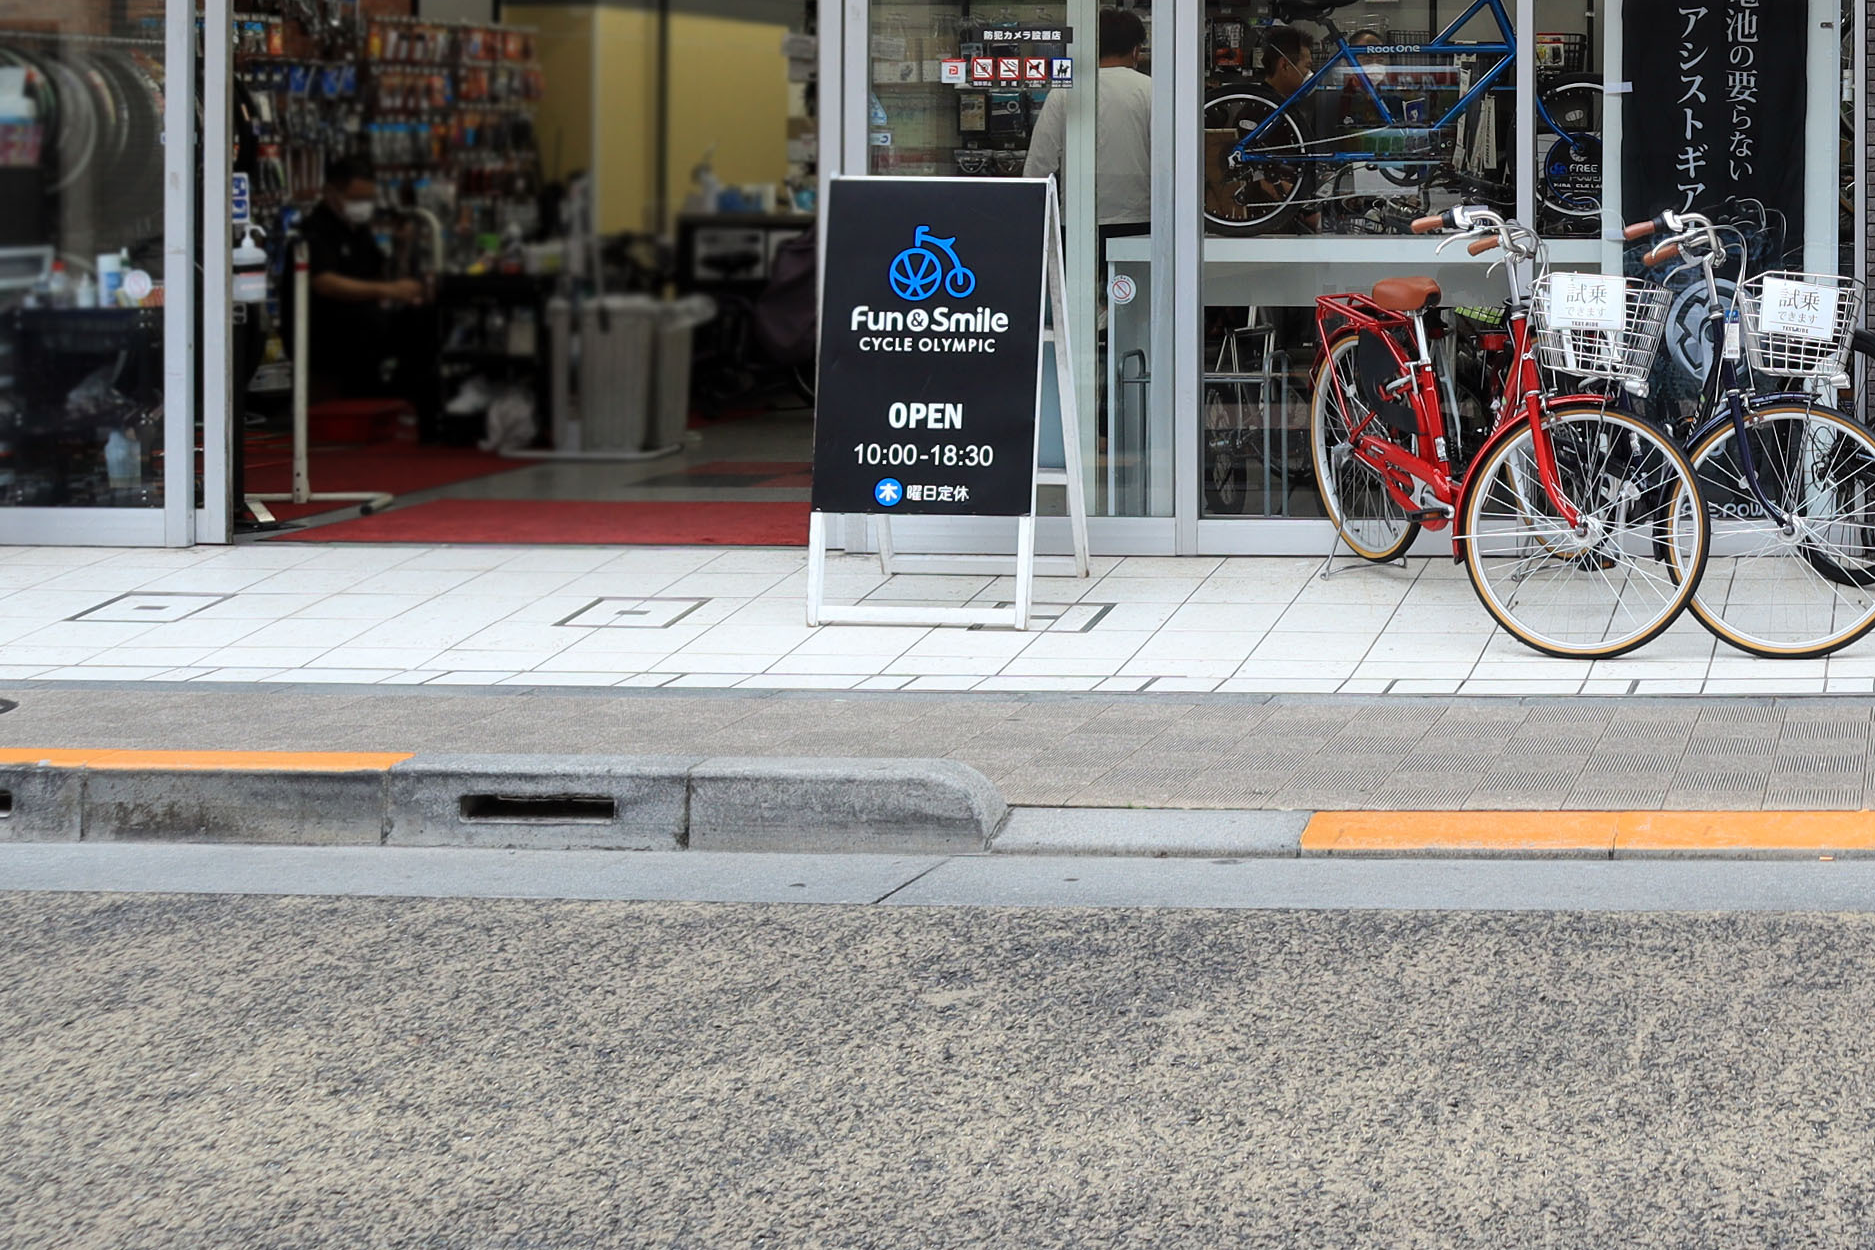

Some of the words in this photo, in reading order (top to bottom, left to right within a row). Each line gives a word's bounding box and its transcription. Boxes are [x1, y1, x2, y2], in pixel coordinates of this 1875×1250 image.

[983, 31, 1062, 41] 防犯カメラ設置店
[1676, 6, 1708, 228] アシストギア
[1569, 164, 1598, 173] FREE
[1566, 283, 1608, 304] 試乗
[1779, 288, 1820, 312] 試乗
[851, 306, 903, 331] Fun
[930, 307, 1009, 333] Smile
[1778, 311, 1818, 324] できます
[859, 337, 912, 352] CYCLE
[919, 337, 996, 353] OLYMPIC
[888, 402, 963, 430] OPEN
[853, 443, 994, 467] 10:00-18:30
